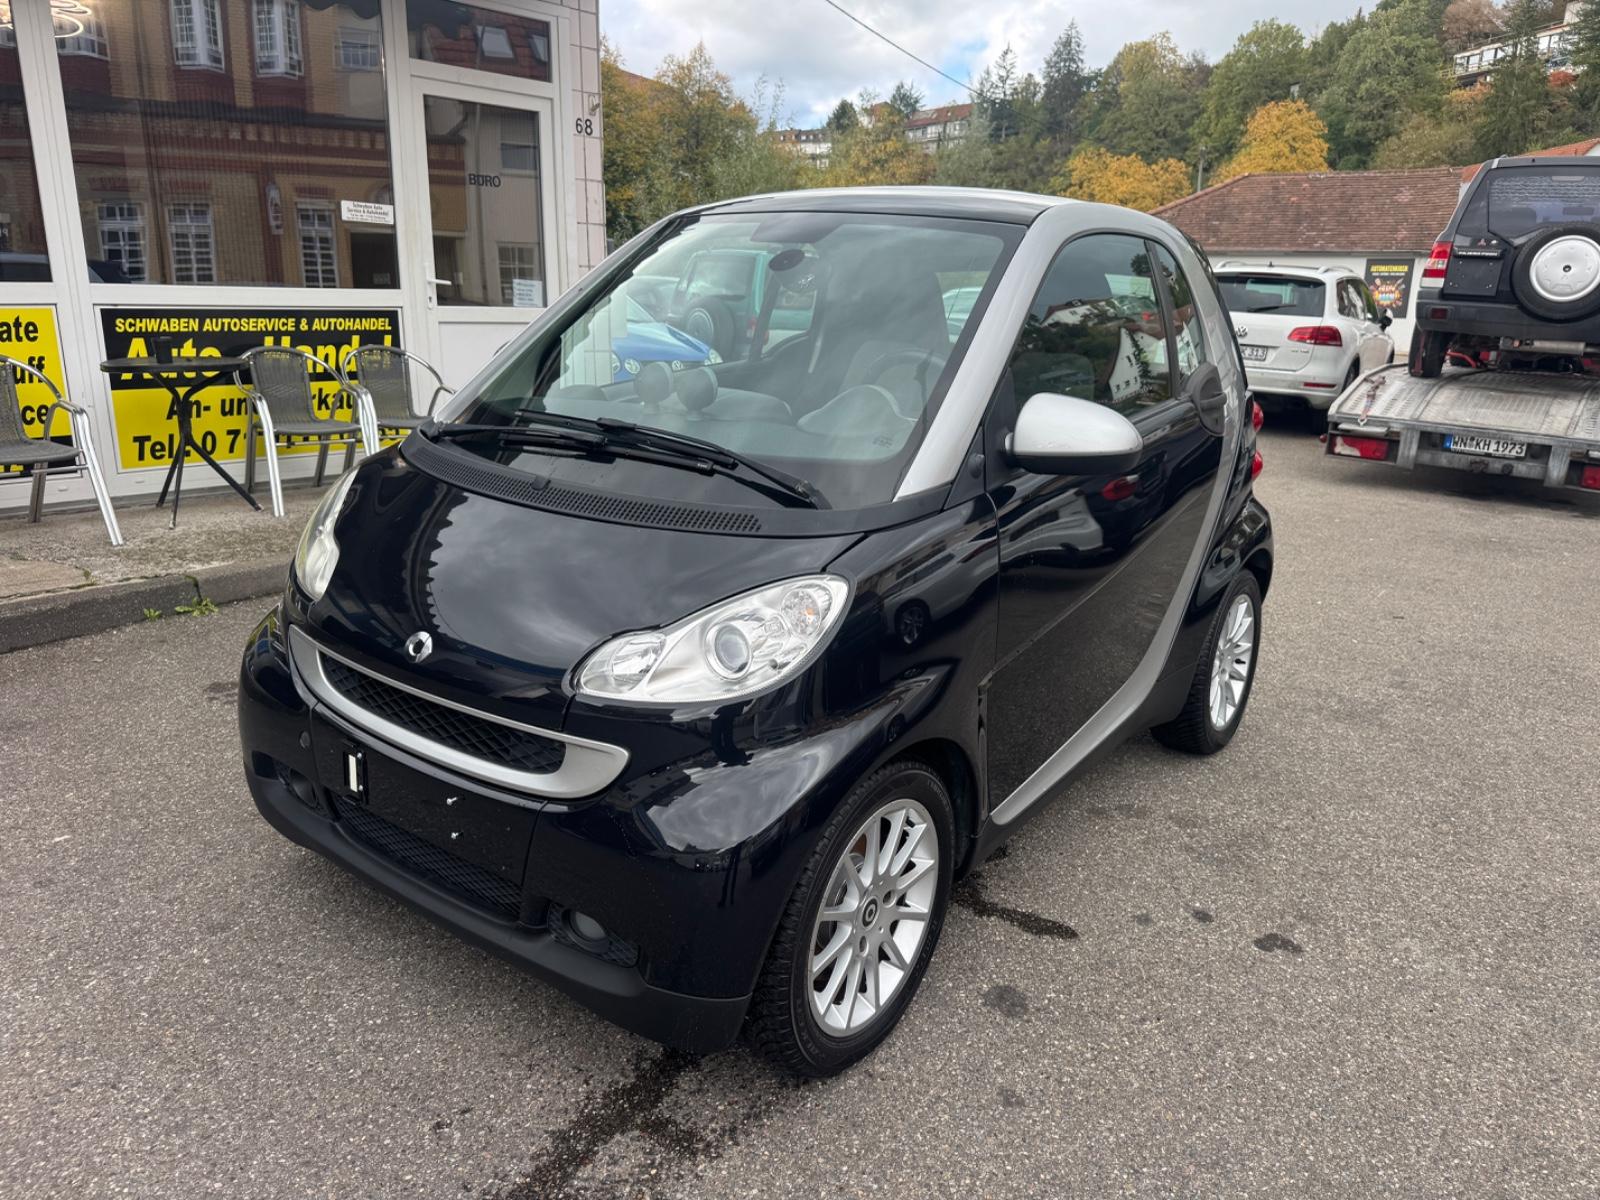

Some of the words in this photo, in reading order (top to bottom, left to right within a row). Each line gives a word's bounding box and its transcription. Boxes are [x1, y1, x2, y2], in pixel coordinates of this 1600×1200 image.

[575, 117, 594, 136] 68
[115, 317, 199, 332] SCHWABEN
[203, 317, 296, 332] AUTOSERVICE
[299, 317, 309, 331] &
[312, 317, 392, 331] AUTOHANDEL
[1475, 438, 1491, 451] KH
[1493, 440, 1524, 455] 1973
